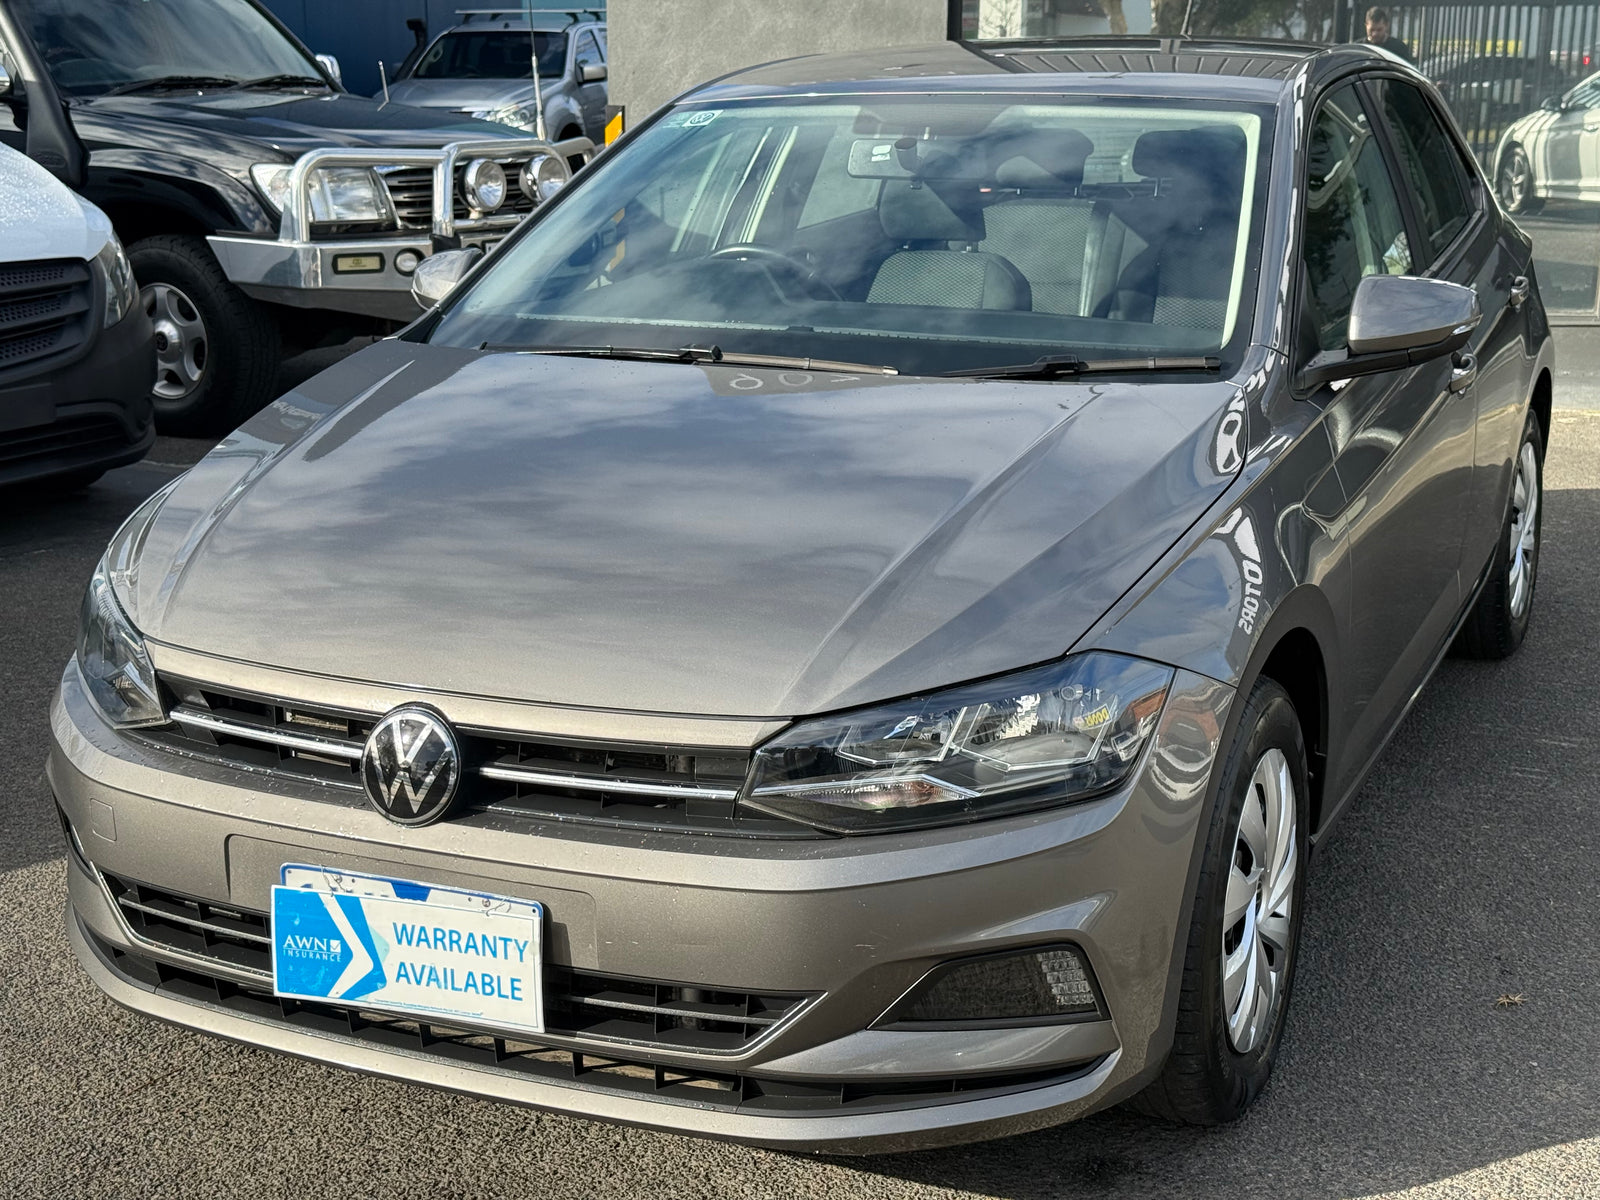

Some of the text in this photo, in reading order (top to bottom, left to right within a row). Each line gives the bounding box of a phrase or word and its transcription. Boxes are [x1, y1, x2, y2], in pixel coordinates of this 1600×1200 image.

[283, 934, 328, 952] AWN
[283, 949, 342, 963] INSURANCE
[392, 921, 530, 963] WARRANTY
[395, 961, 524, 1001] AVAILABLE
